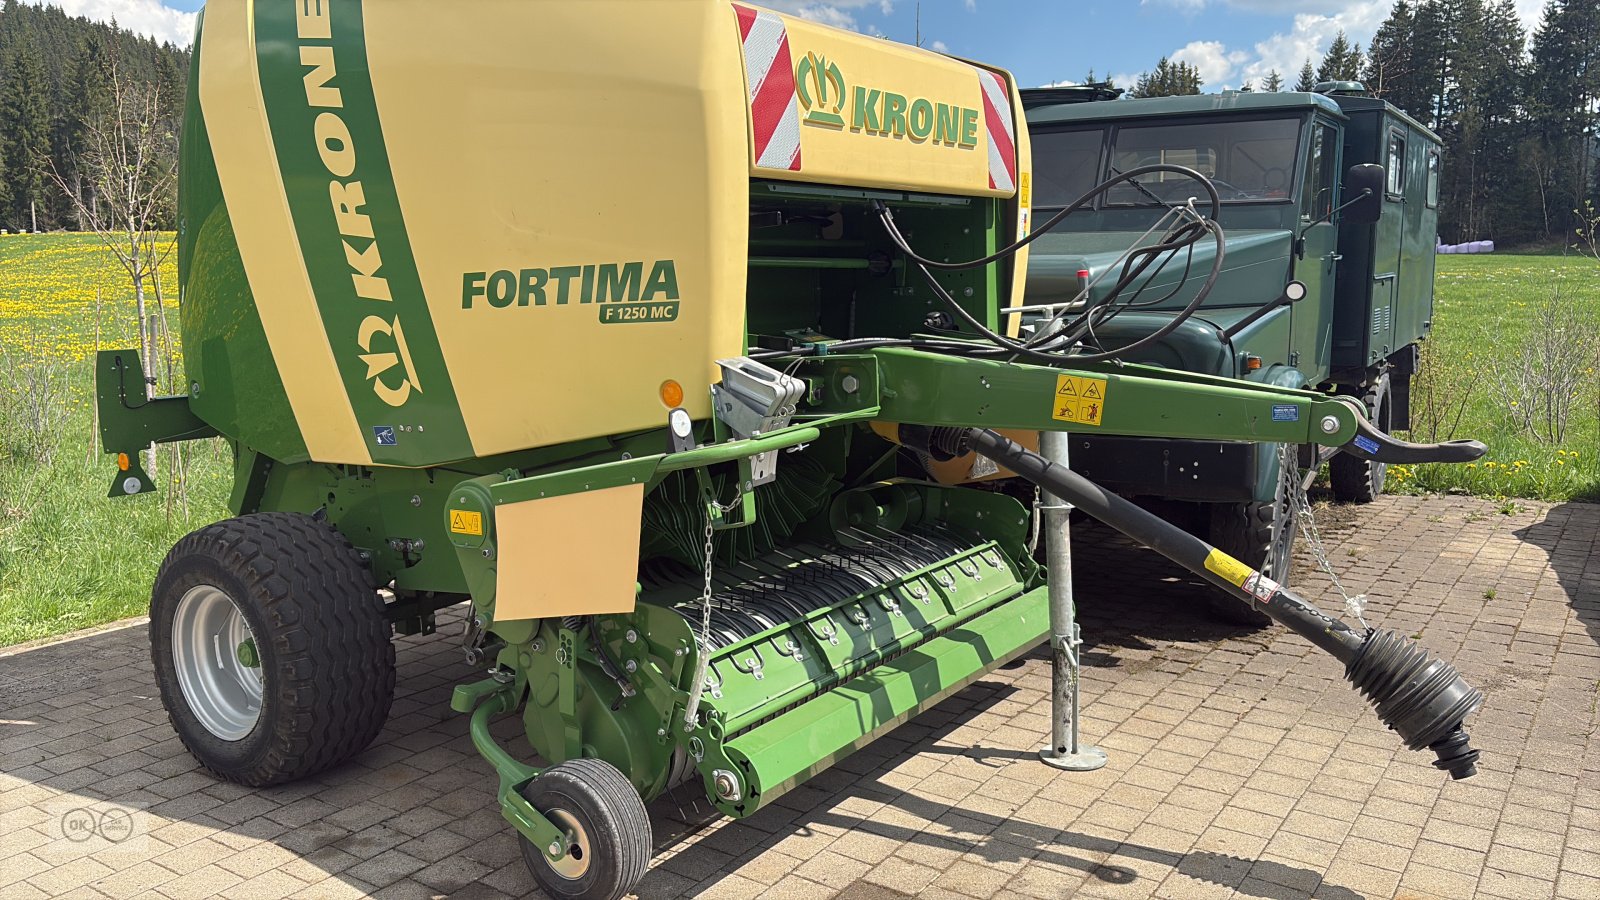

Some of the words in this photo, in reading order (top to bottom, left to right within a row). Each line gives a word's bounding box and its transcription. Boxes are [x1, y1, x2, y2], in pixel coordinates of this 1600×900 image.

[850, 86, 978, 150] KRONE
[296, 0, 393, 302] KRONE
[461, 259, 680, 309] FORTIMA
[605, 308, 614, 320] F
[617, 307, 648, 320] 1250
[651, 305, 673, 318] MC
